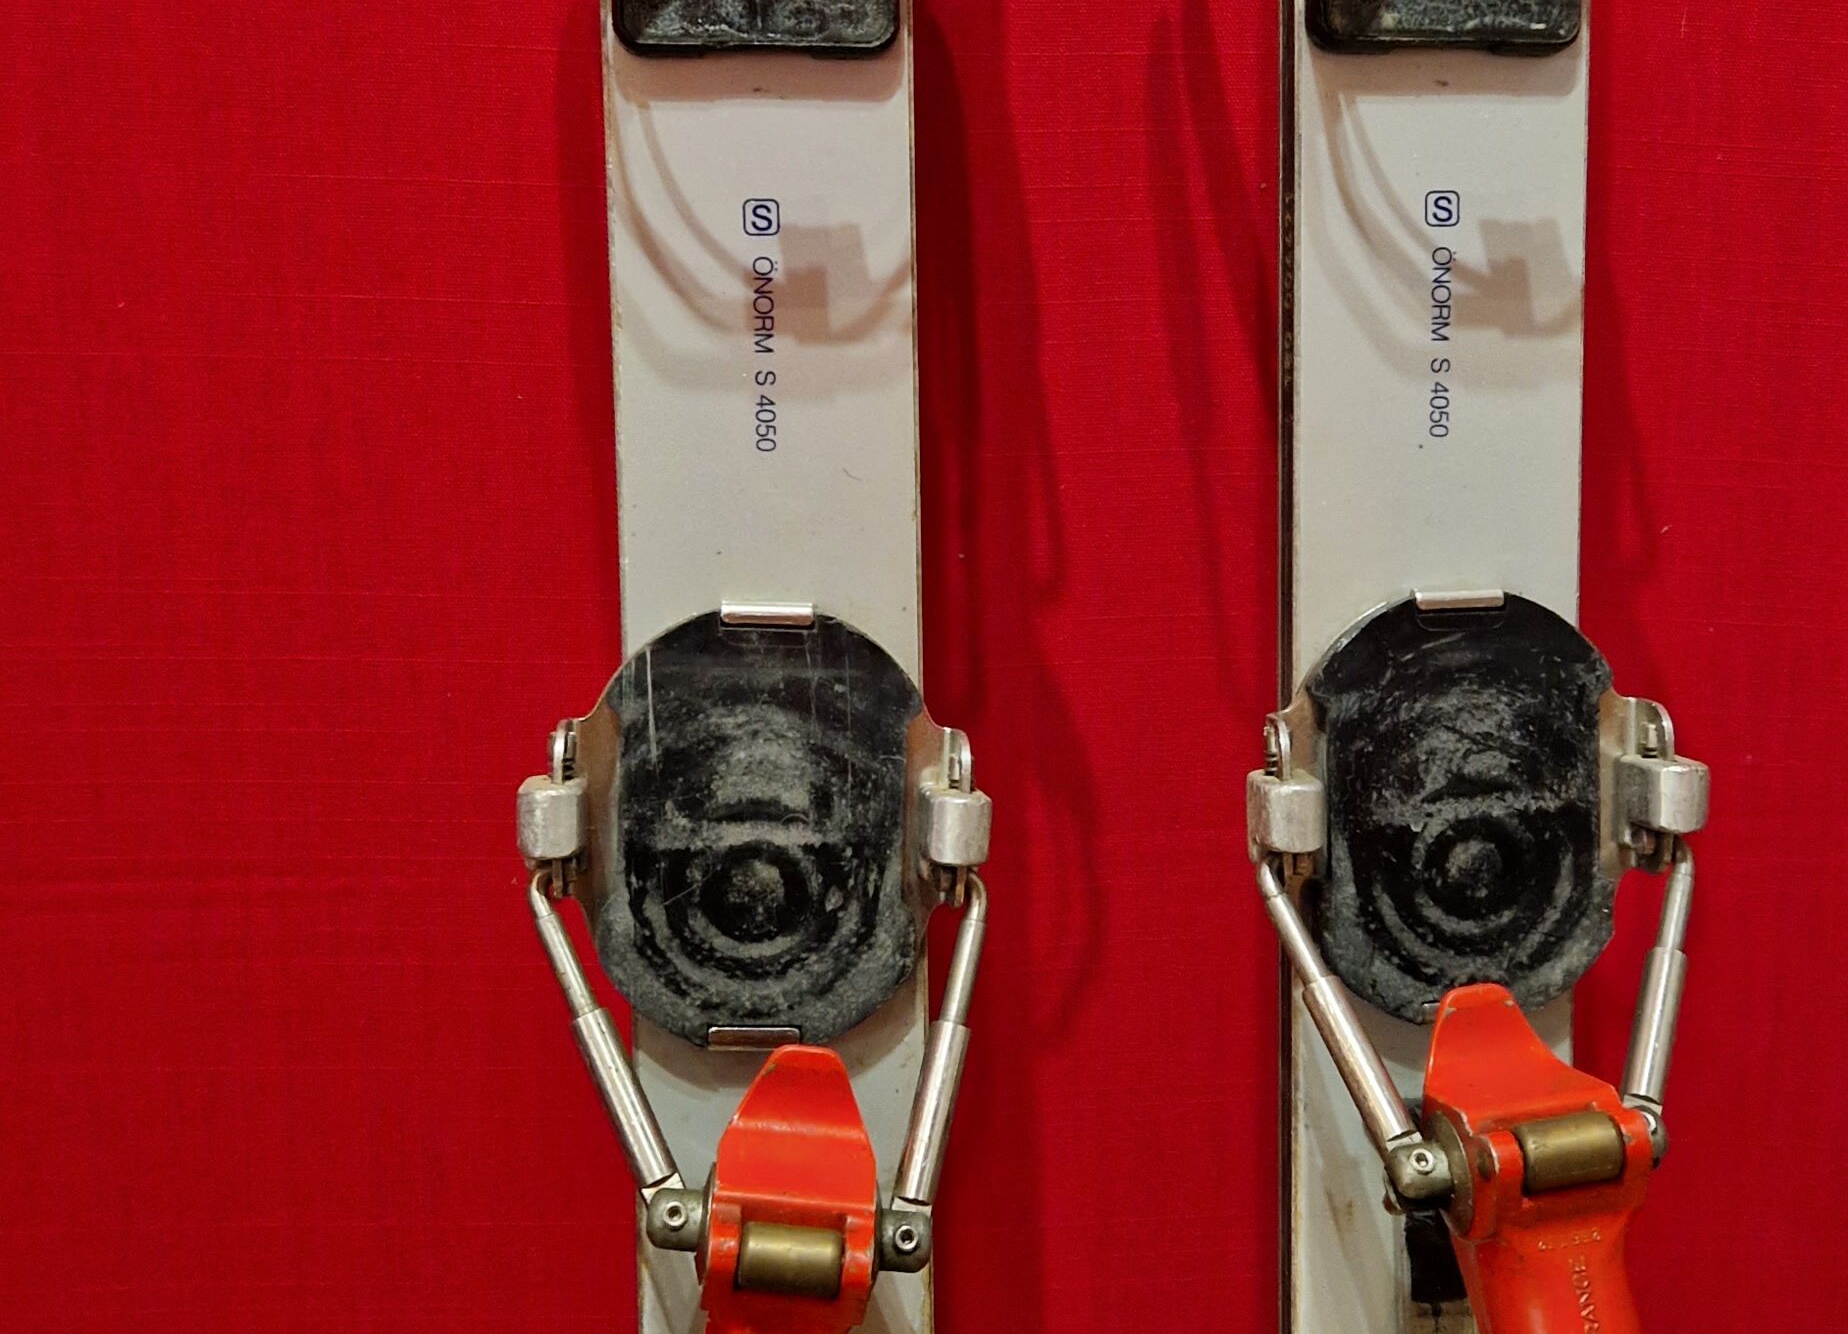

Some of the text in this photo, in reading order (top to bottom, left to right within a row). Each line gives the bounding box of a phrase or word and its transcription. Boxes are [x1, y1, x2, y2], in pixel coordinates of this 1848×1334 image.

[751, 204, 772, 231] S
[1432, 196, 1452, 222] S
[752, 257, 779, 452] ÖNORM S 4050
[1428, 247, 1455, 438] ÖNORM S 4050
